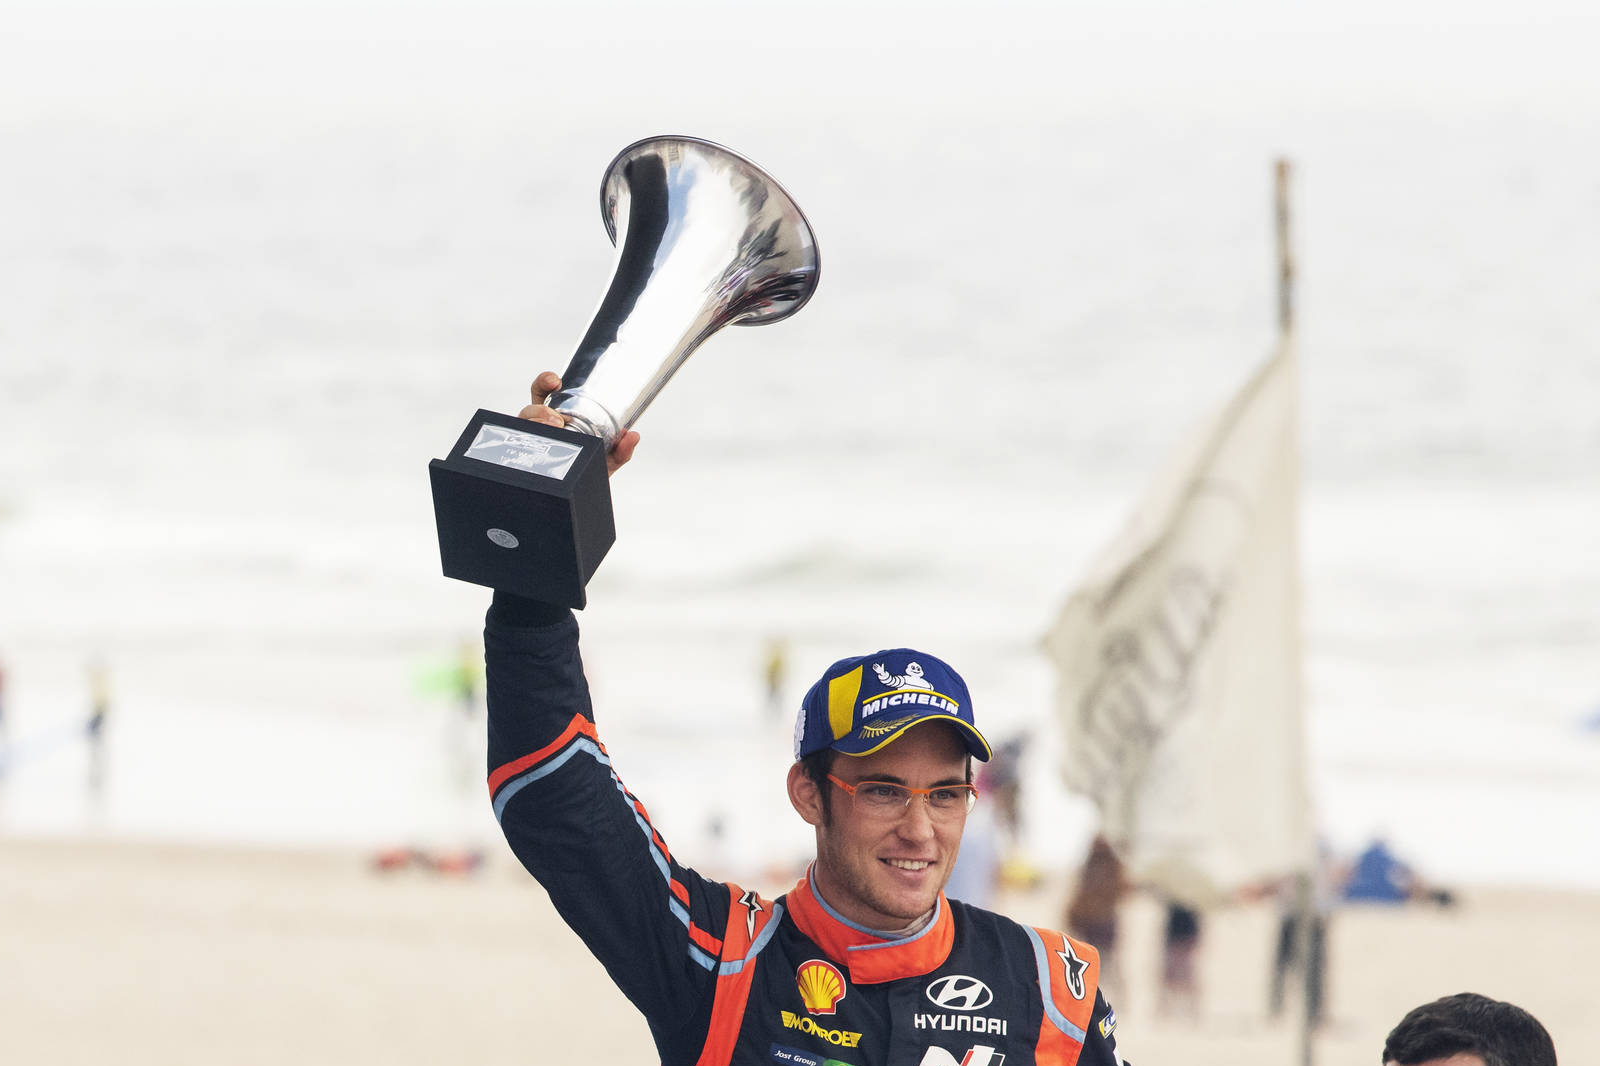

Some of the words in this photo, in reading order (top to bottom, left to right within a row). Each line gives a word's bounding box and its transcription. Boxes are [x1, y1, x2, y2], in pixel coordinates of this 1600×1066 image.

[862, 692, 959, 719] MICHELIN
[786, 1014, 858, 1048] MONROE
[913, 1013, 1008, 1036] HYUNDAI
[775, 1049, 792, 1060] Jost
